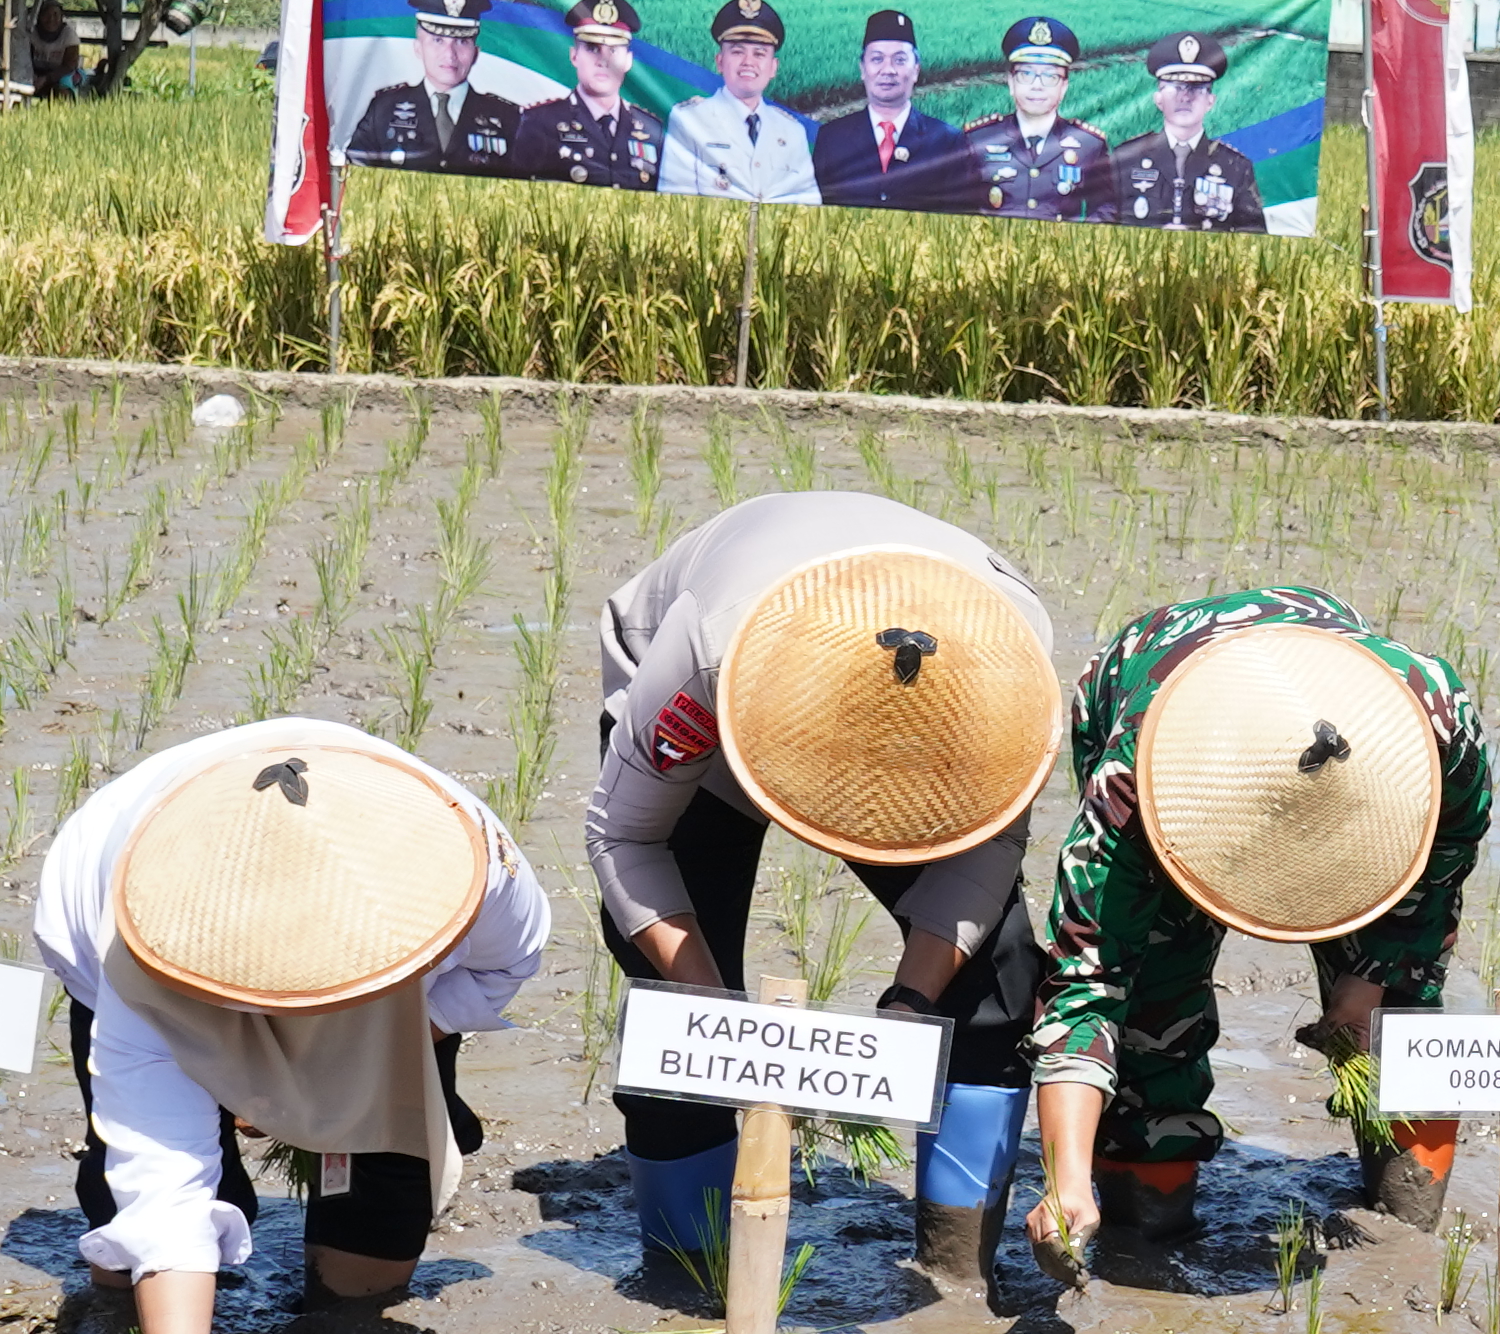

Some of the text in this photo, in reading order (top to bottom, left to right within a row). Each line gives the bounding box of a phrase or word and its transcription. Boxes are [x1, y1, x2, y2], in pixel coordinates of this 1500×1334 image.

[686, 1011, 879, 1060] KAPOLRES
[659, 1049, 894, 1103] BLITAR KOTA
